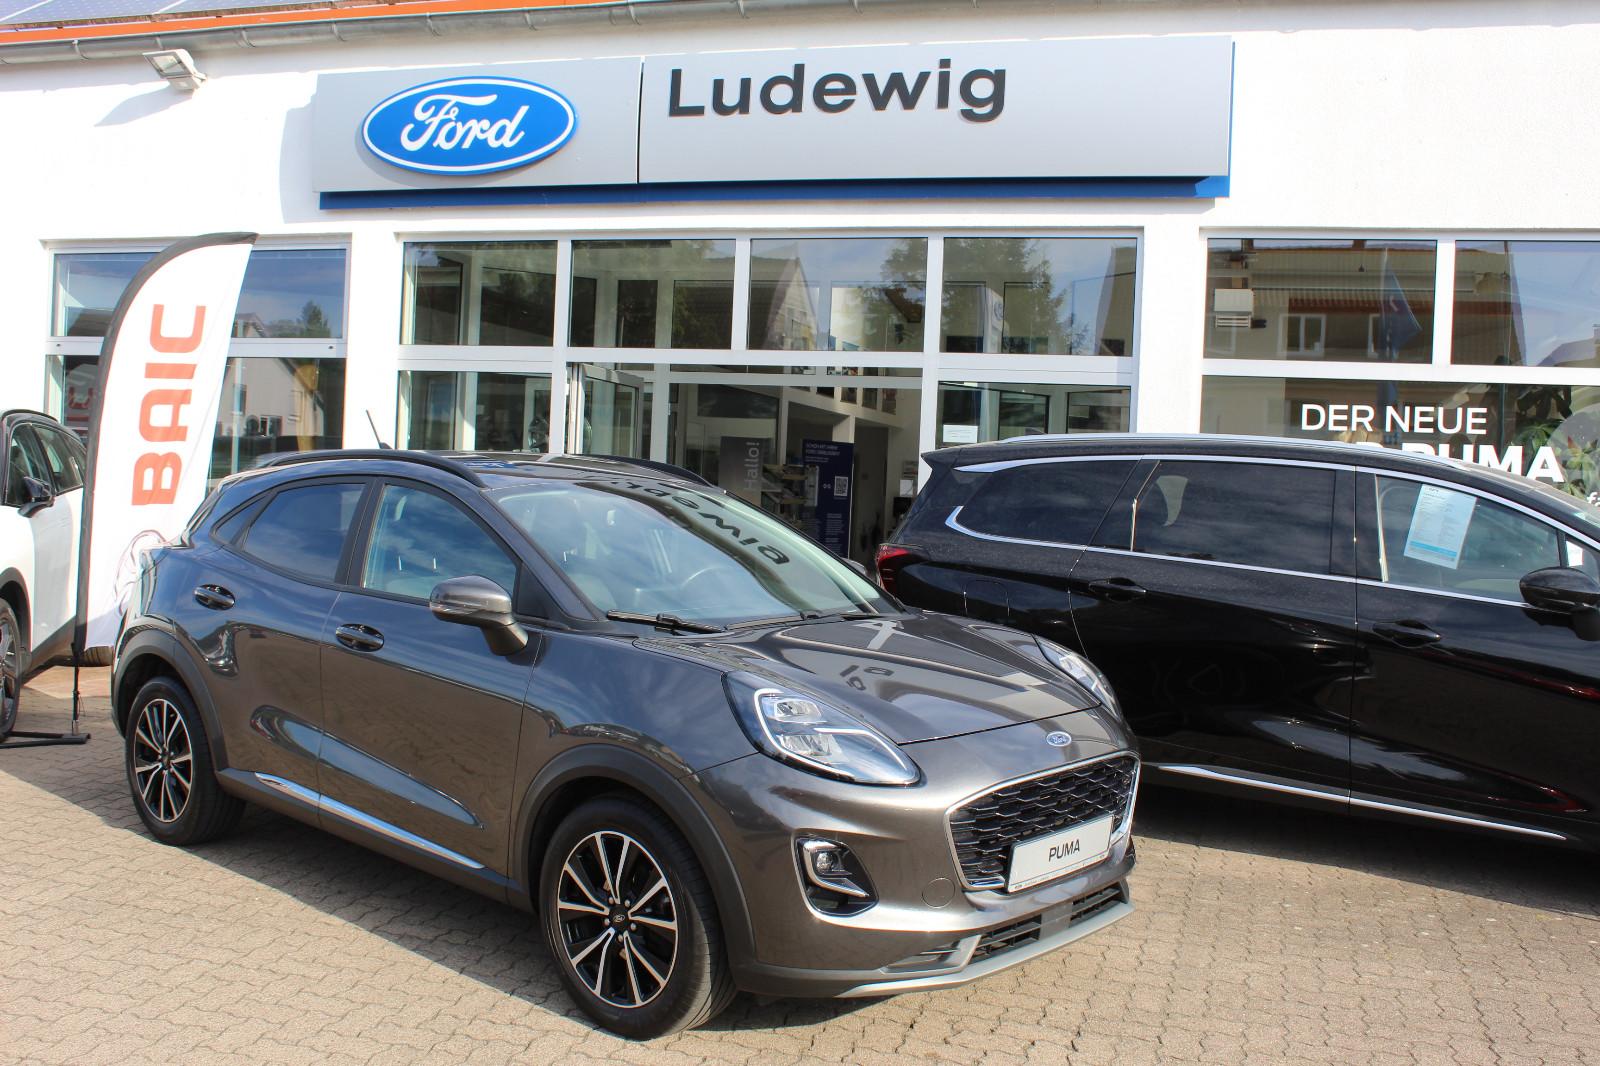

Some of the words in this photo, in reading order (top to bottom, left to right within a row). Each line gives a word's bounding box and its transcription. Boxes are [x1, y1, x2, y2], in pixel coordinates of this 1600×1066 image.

[669, 58, 1006, 122] Ludewig
[401, 94, 530, 152] Ford
[131, 303, 207, 505] BAIC
[1301, 403, 1375, 432] DER
[1385, 405, 1488, 435] NEUE
[743, 441, 760, 491] Hallo!
[1048, 839, 1081, 862] PUMA
